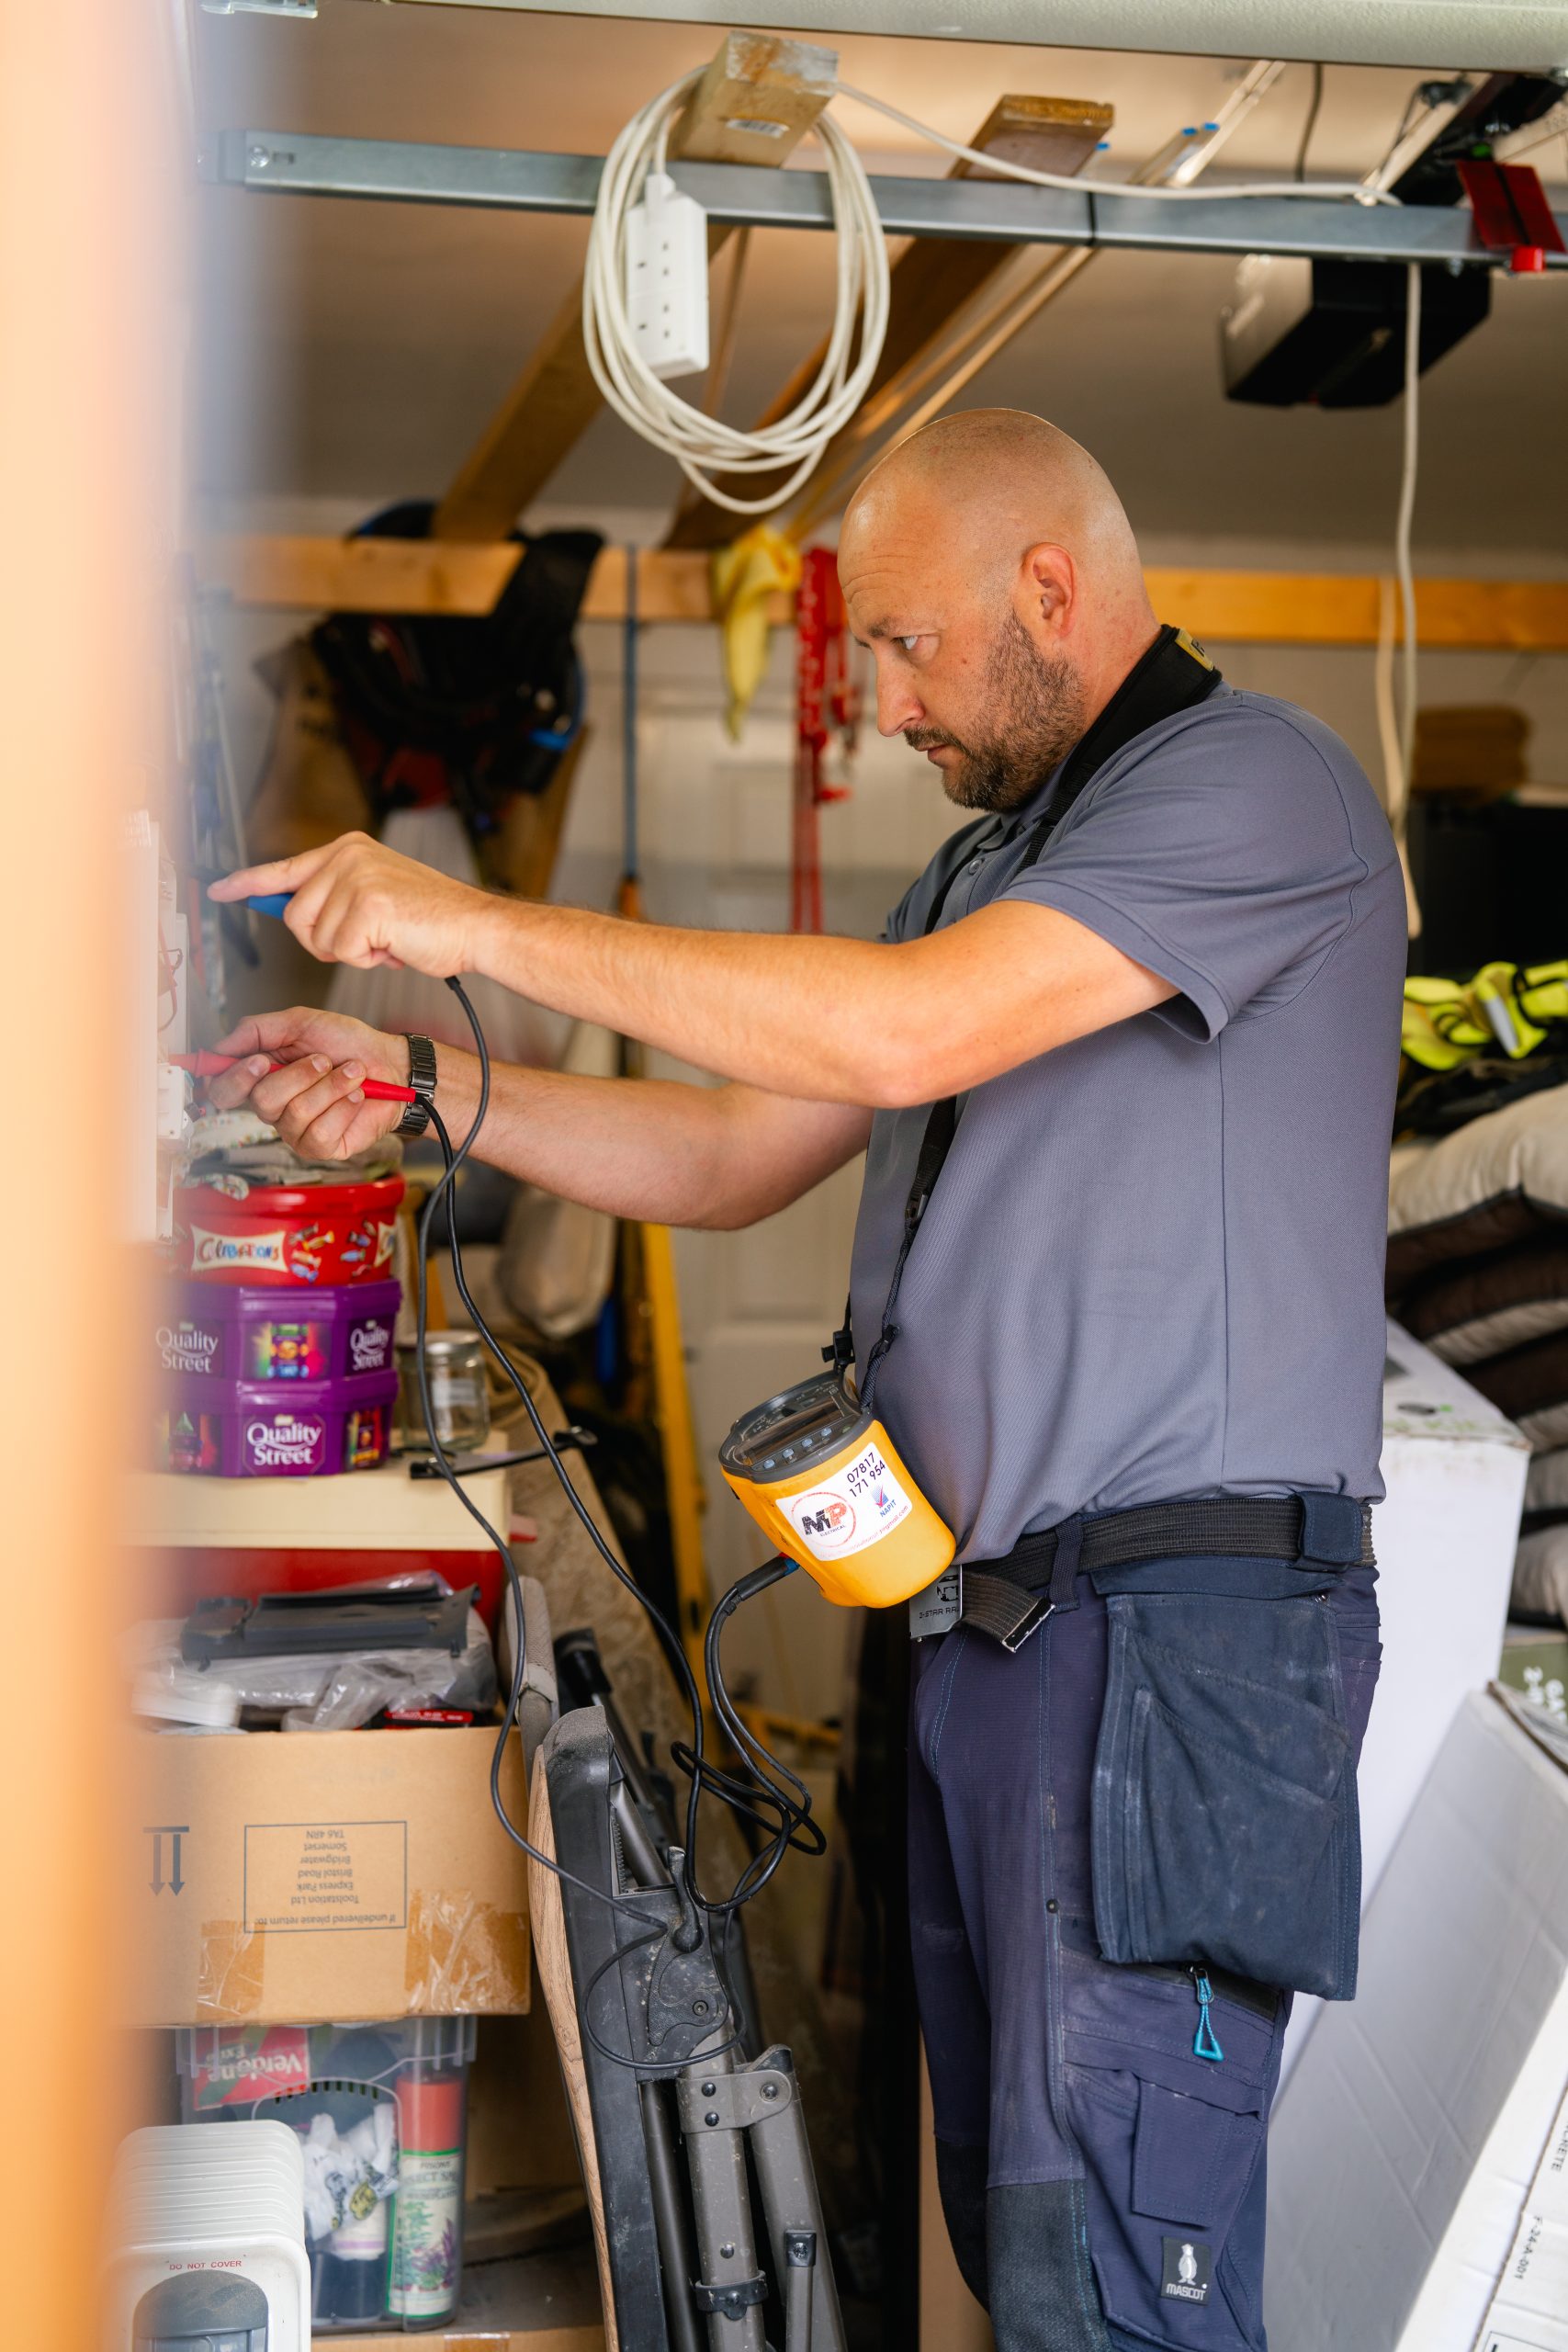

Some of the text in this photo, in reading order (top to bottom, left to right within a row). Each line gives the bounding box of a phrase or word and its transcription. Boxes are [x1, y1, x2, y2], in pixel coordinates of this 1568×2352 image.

[155, 1326, 219, 1358] Quality
[350, 1326, 389, 1354] Quality
[162, 1351, 212, 1374] Street
[353, 1348, 385, 1371] Street
[246, 1421, 321, 1452] Quality
[254, 1444, 314, 1466] Street
[846, 1452, 875, 1484] 07817
[849, 1460, 886, 1498] 171 954
[880, 1499, 897, 1518] NAPIT
[801, 1502, 848, 1536] MP
[820, 1525, 846, 1537] ELECTRICAL
[306, 1829, 344, 1838] TA6 4RN
[304, 1842, 348, 1851] Somerset
[300, 1855, 351, 1865] Bridgwater
[298, 1869, 354, 1879] Bristol Road
[297, 1882, 354, 1892] Express Park
[290, 1894, 359, 1905] Toolstation Ltd
[269, 1917, 299, 1926] return
[300, 1915, 331, 1925] please
[333, 1914, 388, 1924] undelivered
[389, 1914, 396, 1924] If
[207, 2052, 303, 2082] Verdone
[1515, 2215, 1544, 2280] F-24-A-001
[210, 2260, 243, 2268] COVER
[1166, 2283, 1206, 2301] MASCOT
